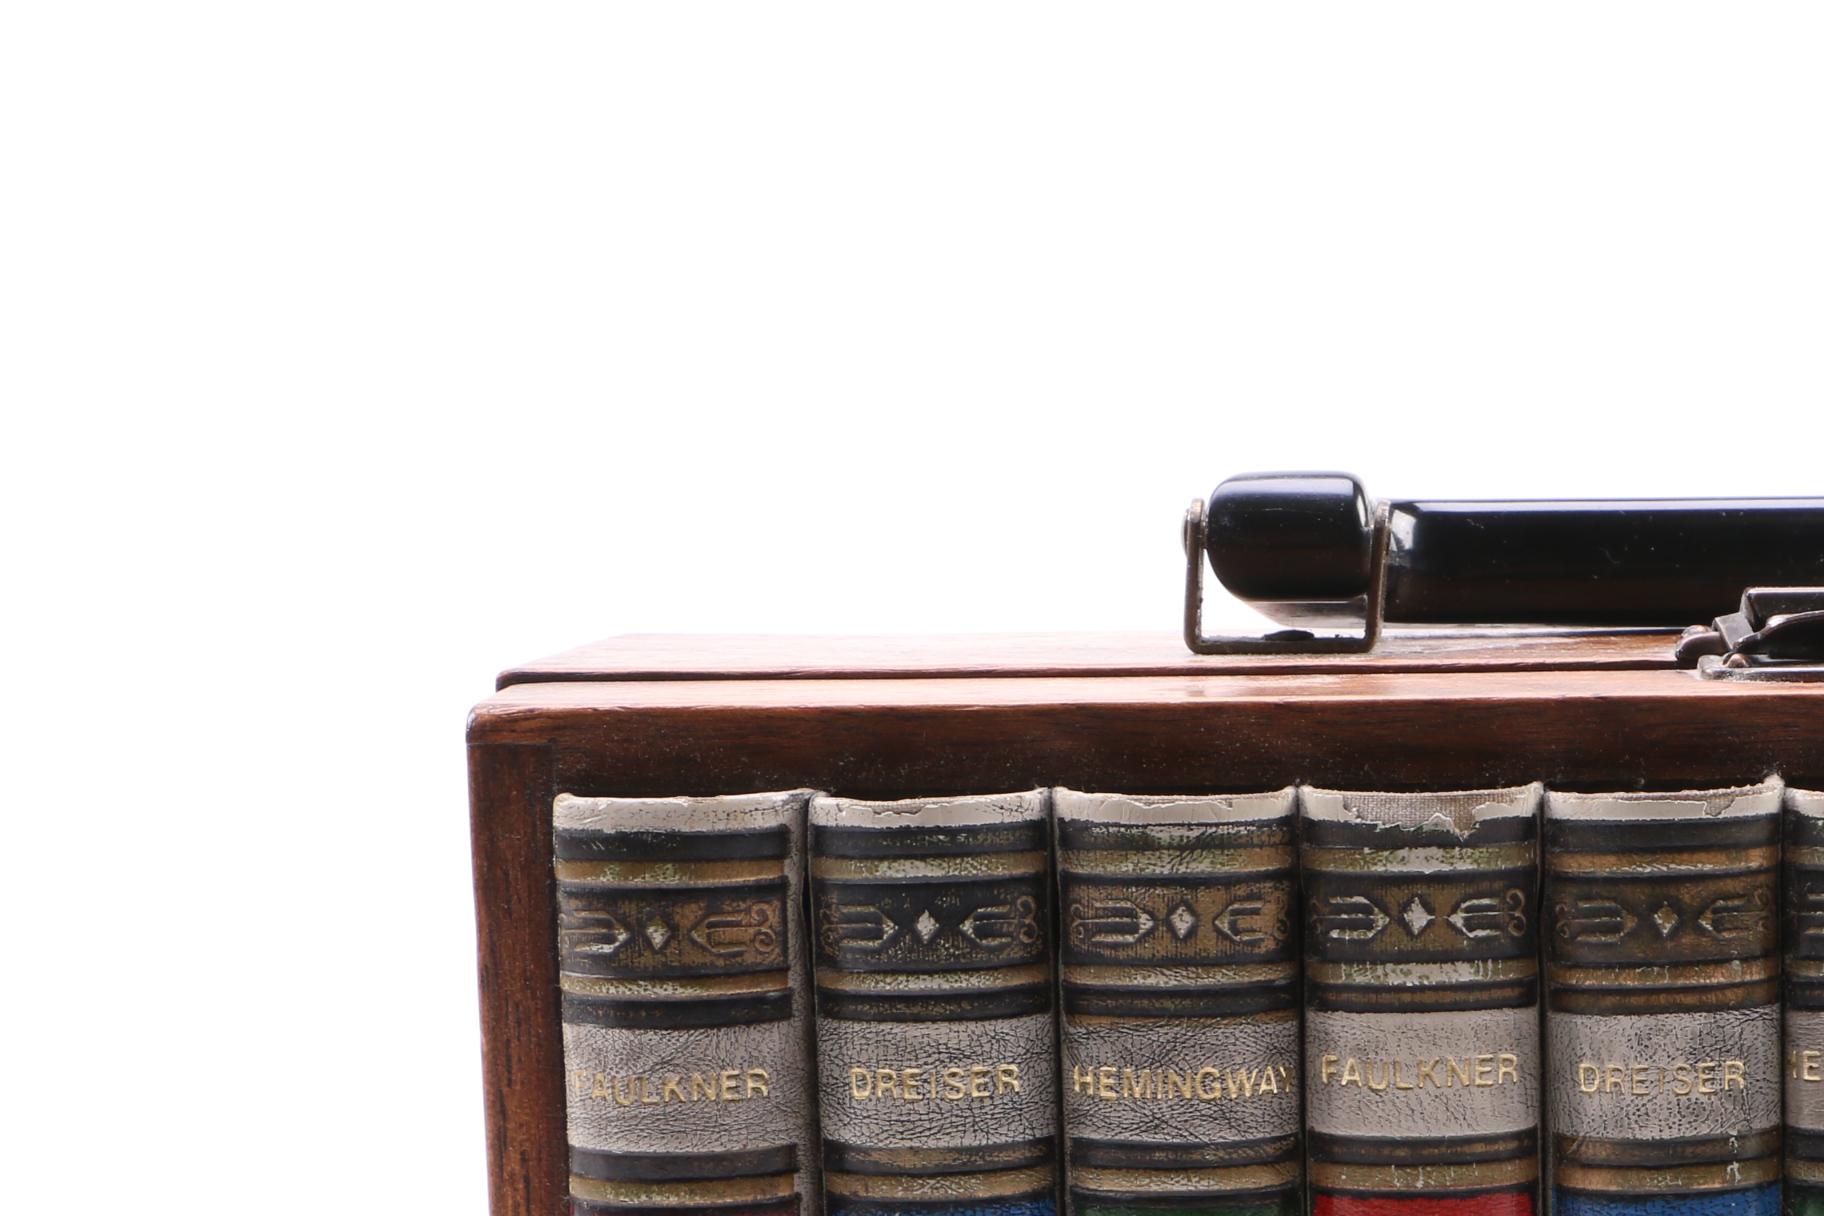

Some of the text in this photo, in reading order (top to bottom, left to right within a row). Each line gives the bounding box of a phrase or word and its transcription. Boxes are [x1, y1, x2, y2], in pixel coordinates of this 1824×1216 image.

[574, 1067, 771, 1106] FAULKNER
[850, 1062, 1022, 1102] DREISER
[1072, 1064, 1294, 1102] HEMINGWAY
[1321, 1052, 1520, 1092] FAULKNER
[1578, 1060, 1746, 1097] DREISER
